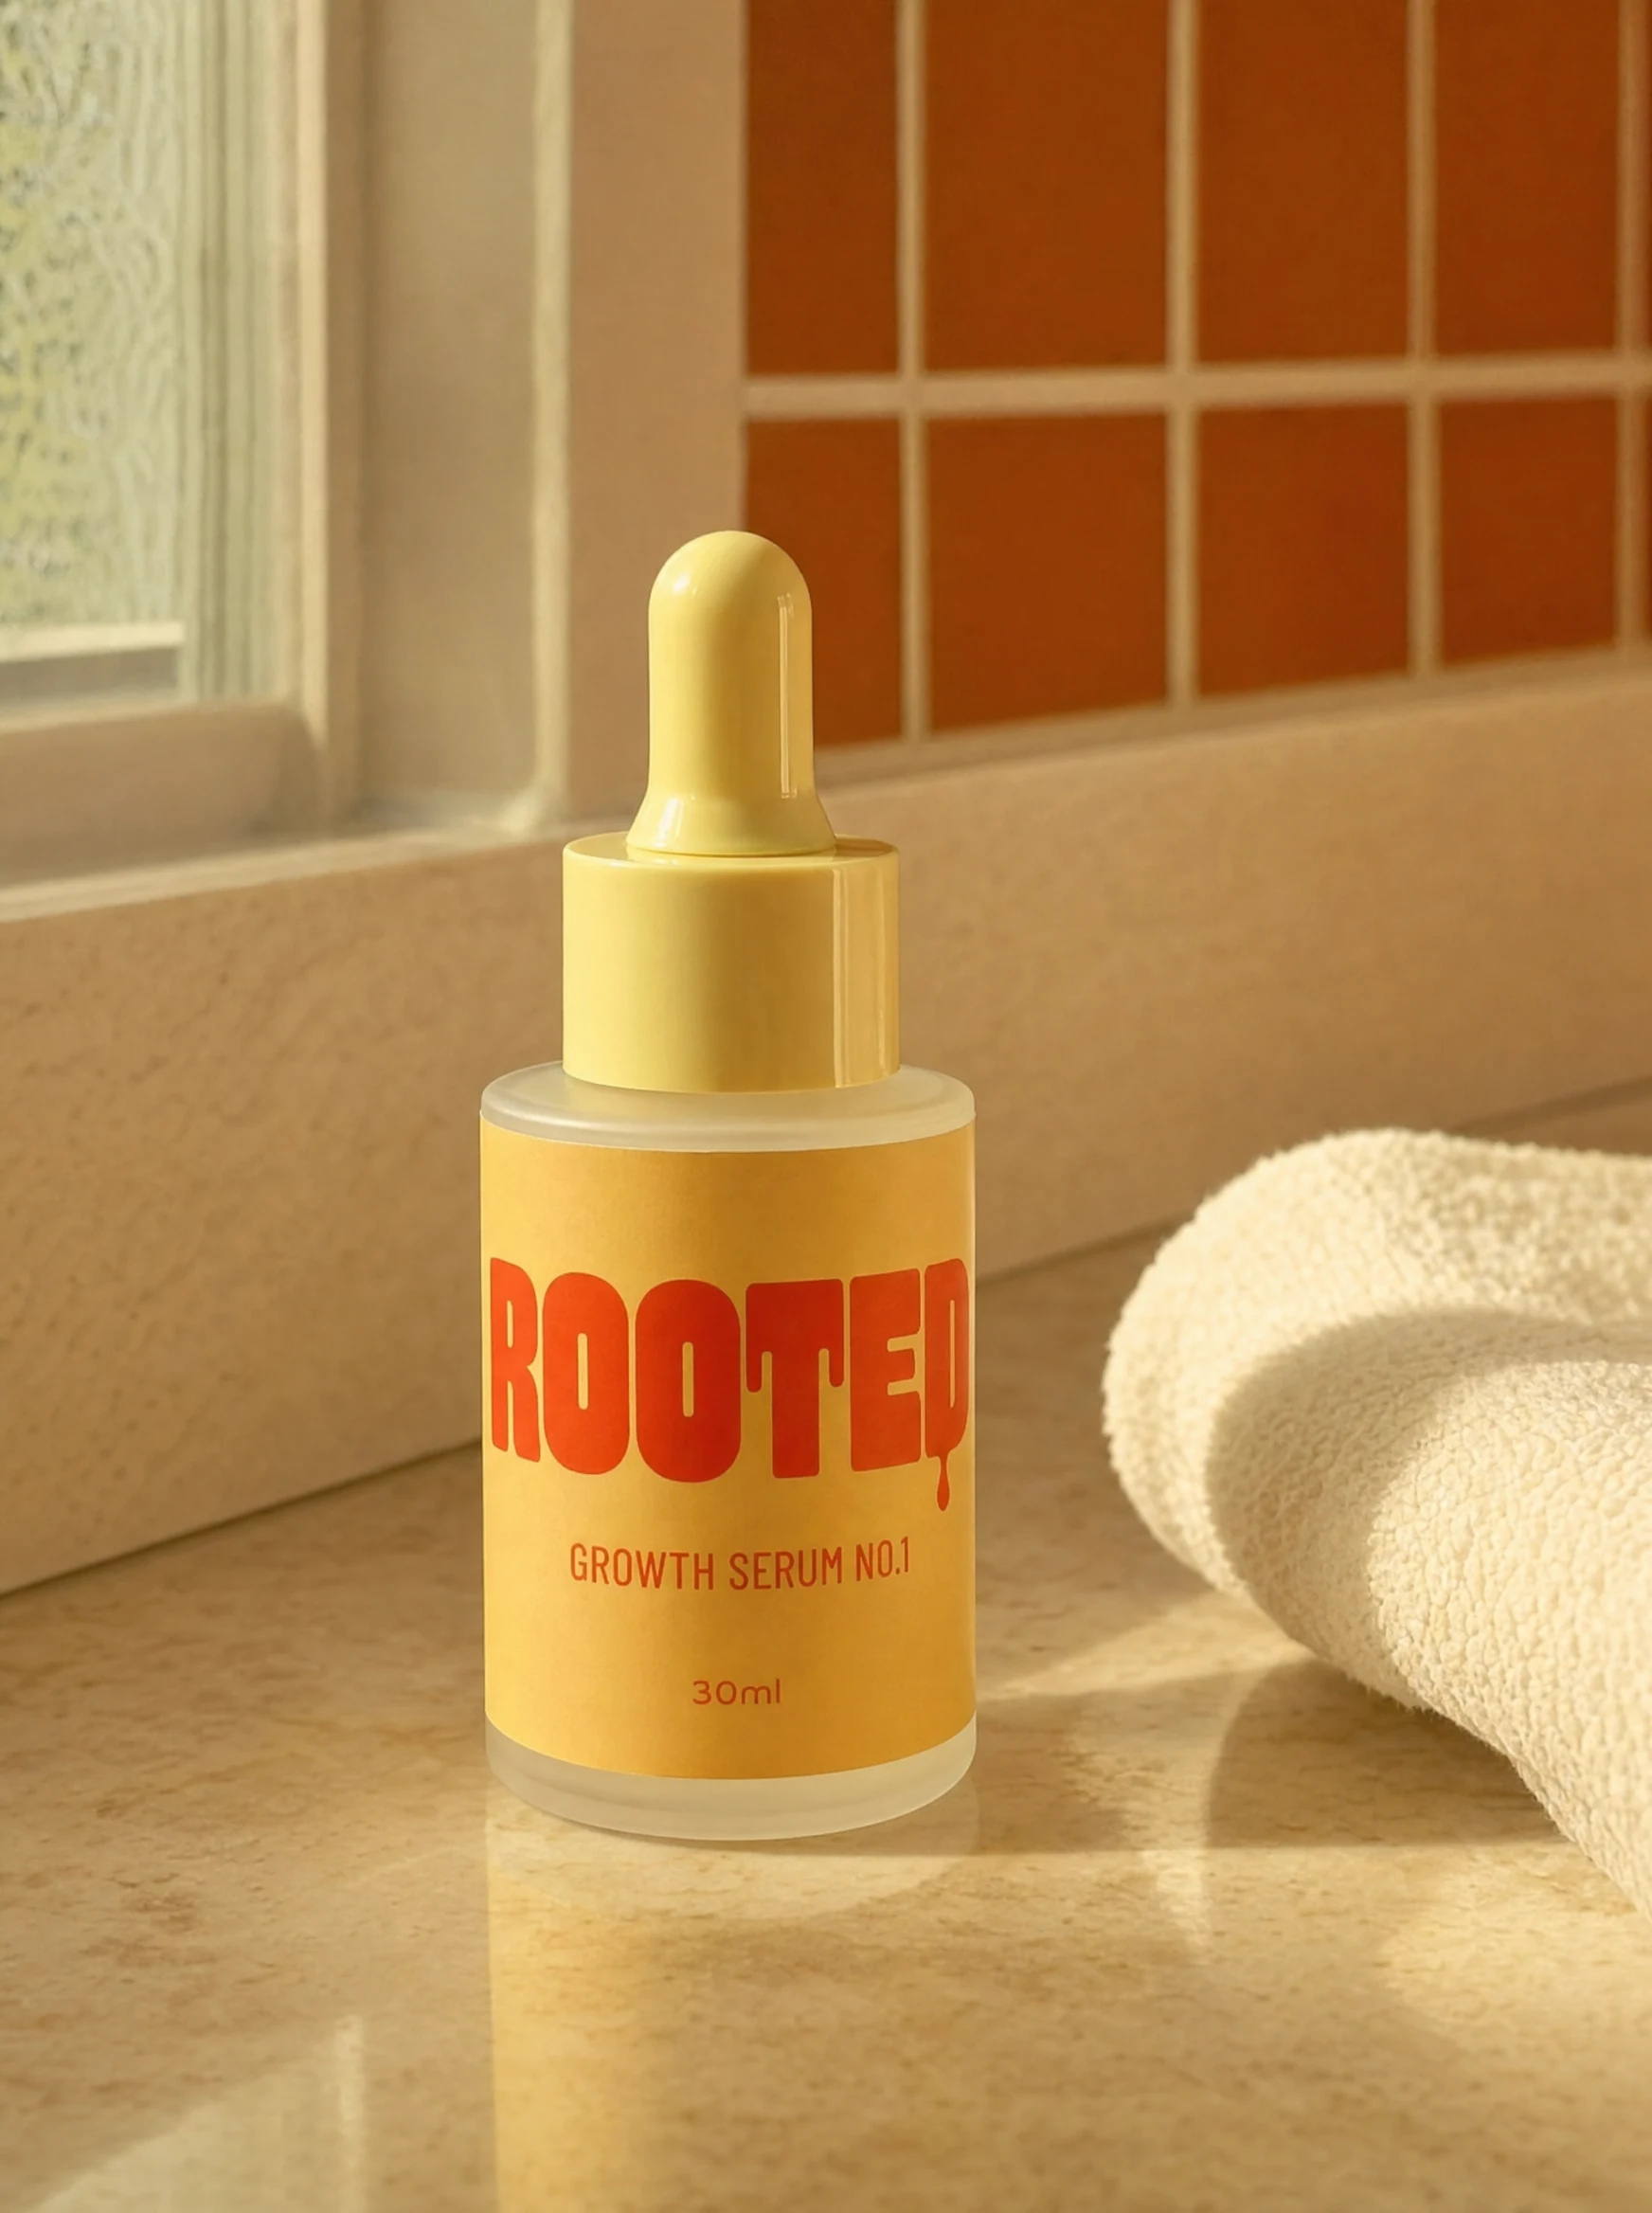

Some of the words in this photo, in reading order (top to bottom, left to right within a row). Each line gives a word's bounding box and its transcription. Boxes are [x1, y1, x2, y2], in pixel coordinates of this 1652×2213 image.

[490, 1257, 969, 1511] ROOTED
[570, 1542, 714, 1591] GROWTH
[728, 1546, 843, 1591] SERUM
[855, 1536, 909, 1582] NO.1
[692, 1678, 781, 1705] 30ml
